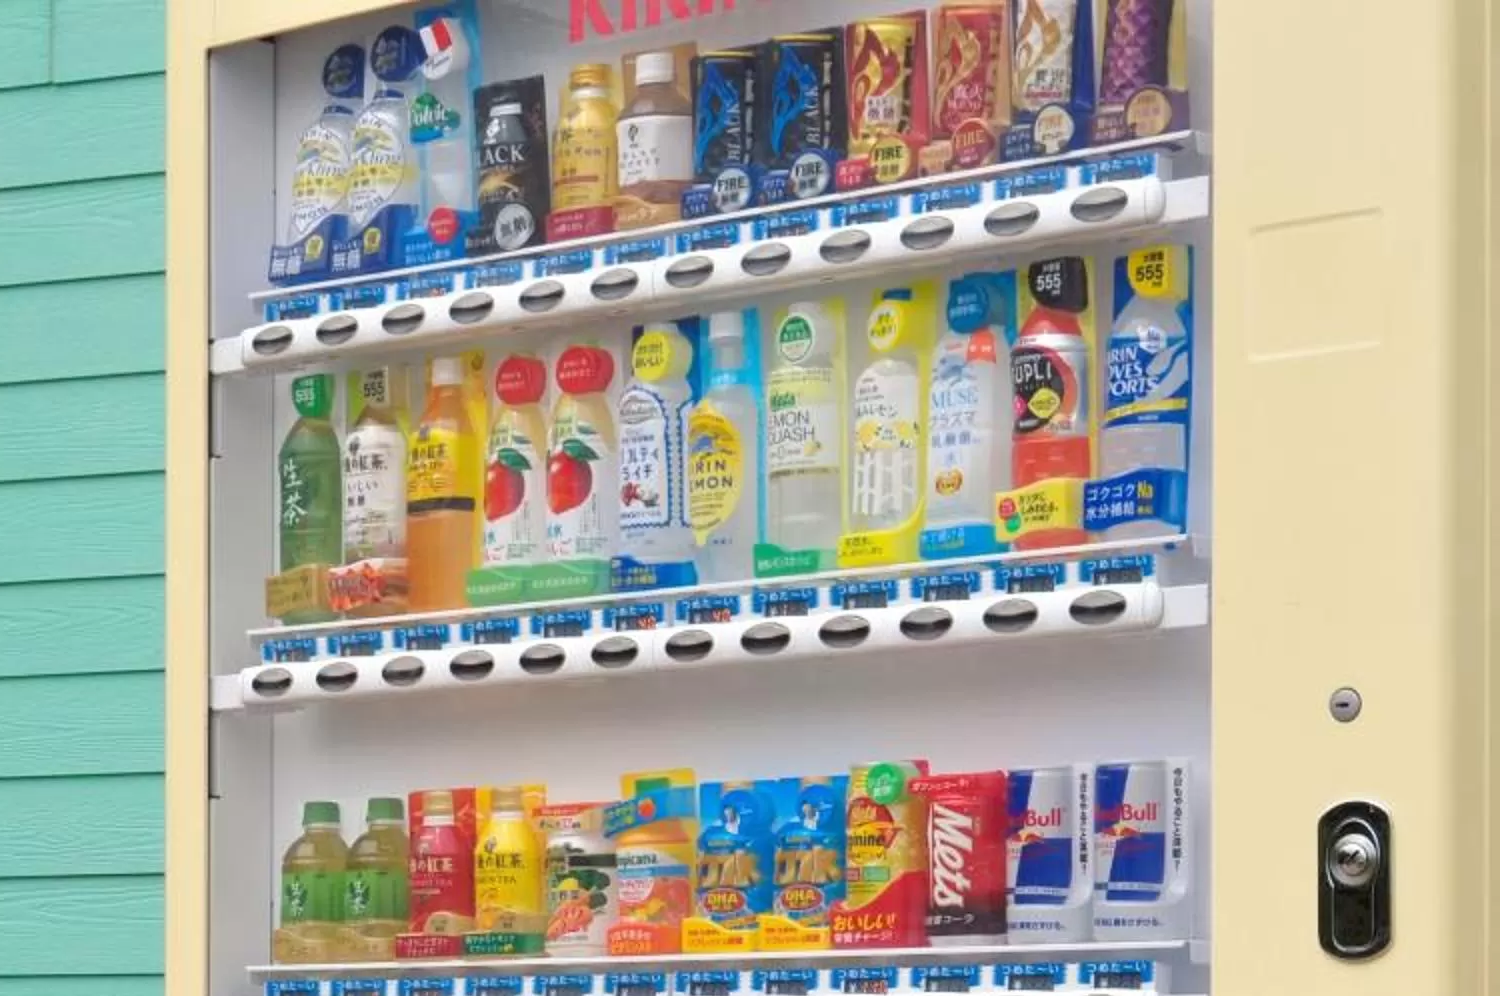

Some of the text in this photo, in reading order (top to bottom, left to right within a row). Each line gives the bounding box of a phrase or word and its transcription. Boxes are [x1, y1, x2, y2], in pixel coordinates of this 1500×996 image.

[569, 0, 736, 43] KIR
[482, 144, 525, 166] ACK
[1036, 274, 1062, 291] 555
[1136, 264, 1164, 283] 555
[281, 457, 309, 527] 生茶
[1087, 483, 1135, 503] ゴクゴク
[1026, 807, 1061, 828] Bull
[1121, 801, 1157, 821] Bull
[933, 802, 974, 908] Mets
